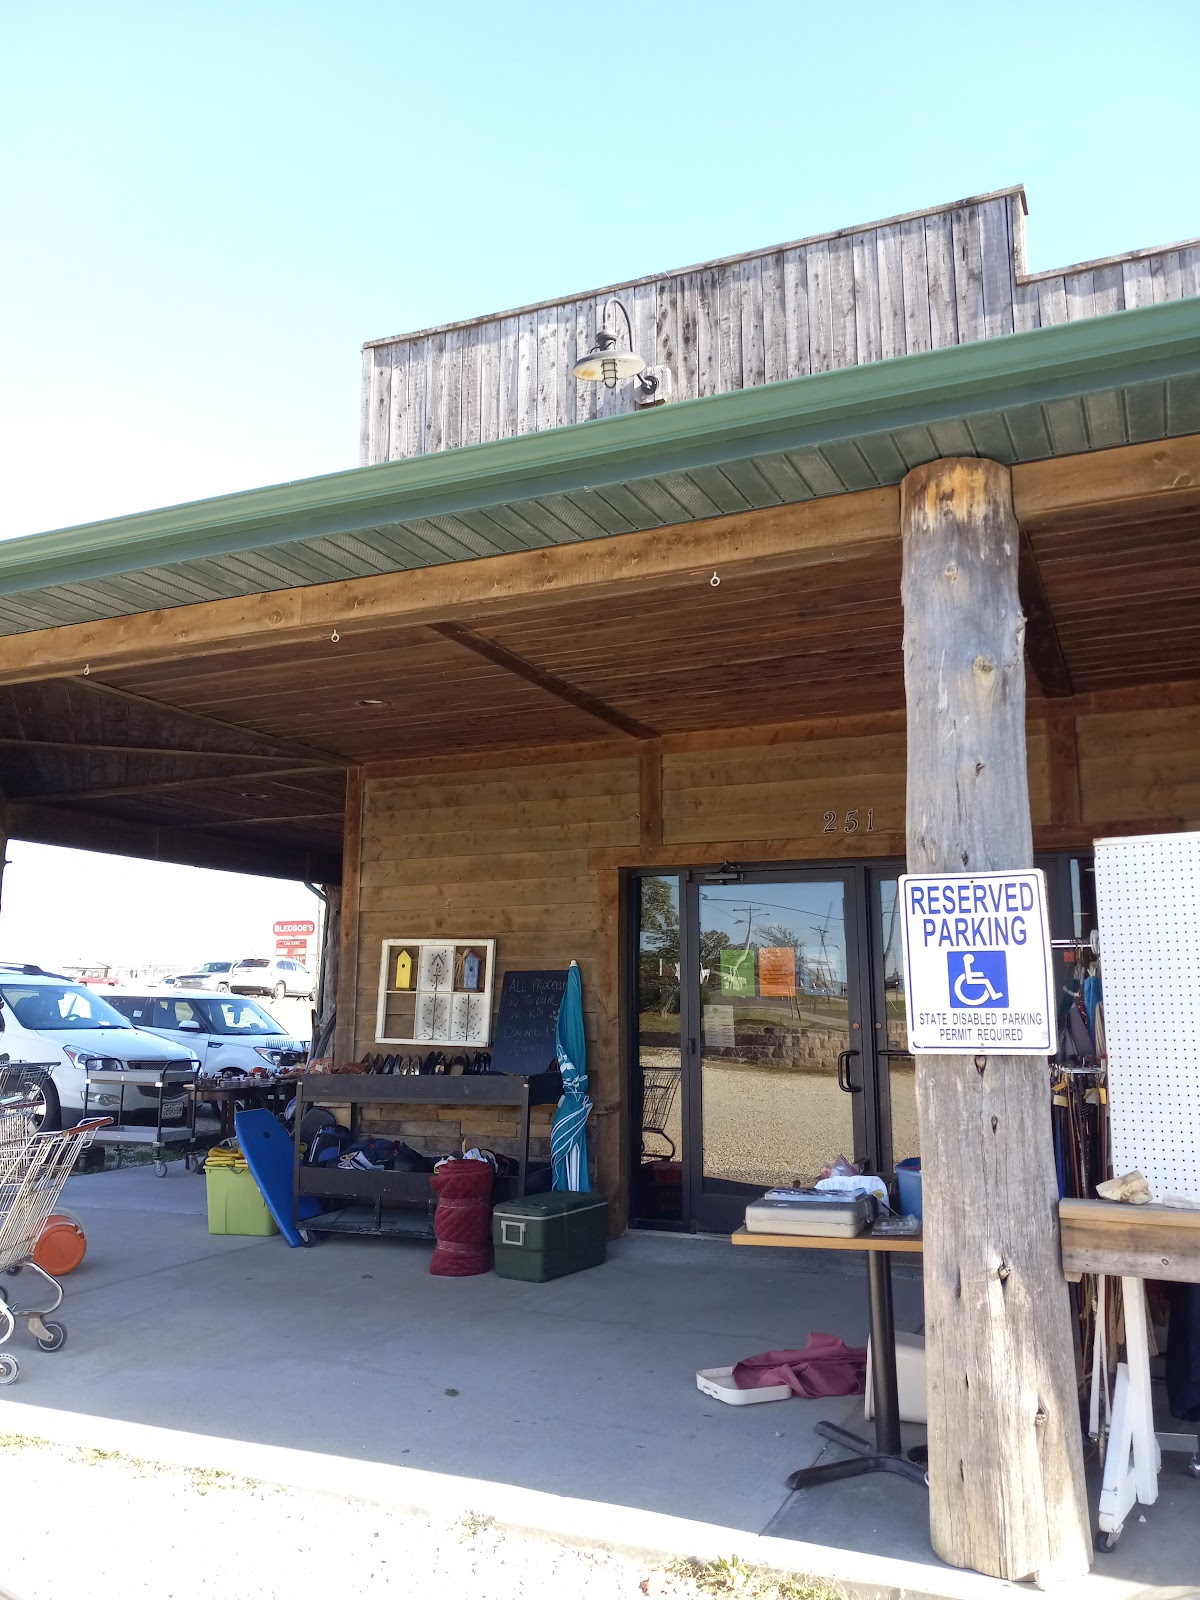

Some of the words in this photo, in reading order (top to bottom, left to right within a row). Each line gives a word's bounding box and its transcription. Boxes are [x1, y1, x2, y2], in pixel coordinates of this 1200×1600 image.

[823, 808, 874, 834] 251
[911, 883, 1034, 915] RESERVED
[274, 924, 313, 932] BLEDSOE'S
[923, 916, 1028, 947] PARKING
[919, 1013, 948, 1026] STATE
[952, 1013, 997, 1026] DISABLED
[1002, 1012, 1042, 1025] PARKING
[940, 1028, 972, 1041] PERMIT
[977, 1028, 1023, 1042] REQUIRED
